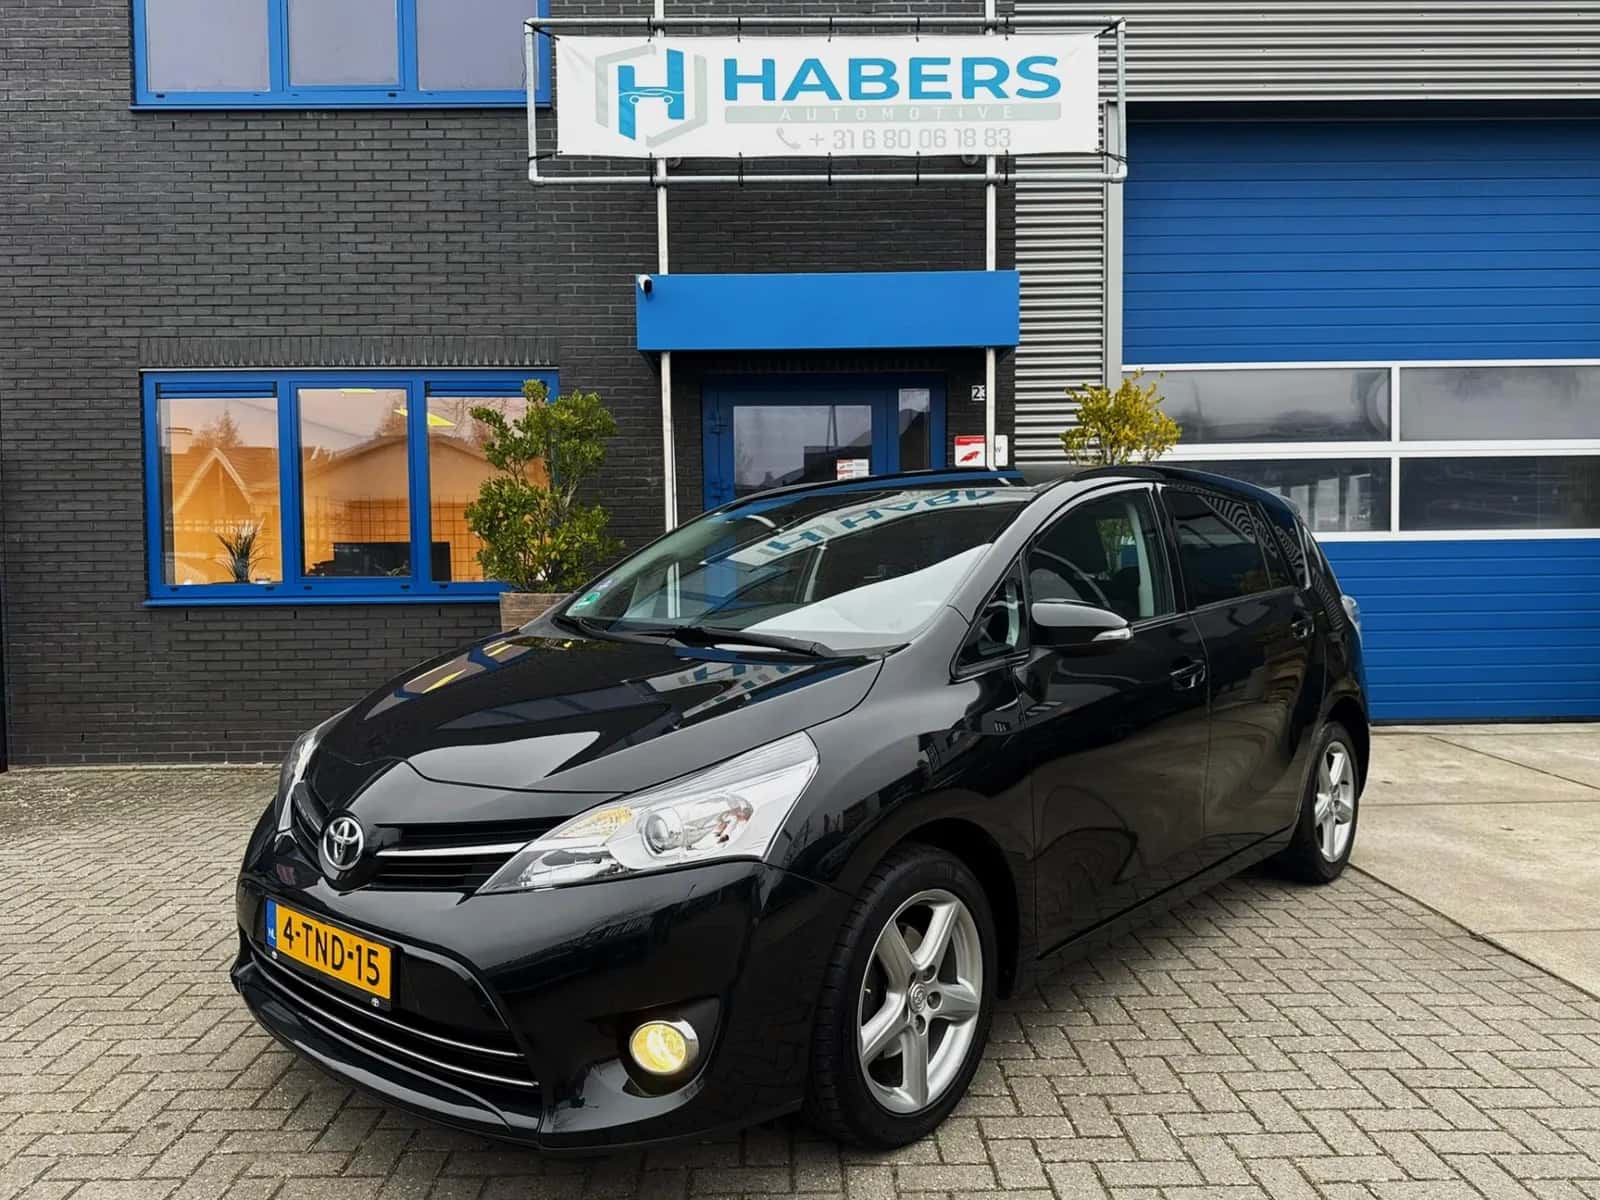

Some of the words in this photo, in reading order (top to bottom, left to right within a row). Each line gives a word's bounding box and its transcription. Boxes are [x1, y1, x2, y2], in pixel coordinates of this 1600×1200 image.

[723, 56, 1062, 101] HABERS
[779, 105, 1014, 121] AUTOMOTIVE
[883, 129, 912, 149] 80
[919, 129, 947, 149] 06
[955, 128, 977, 148] 18
[984, 128, 1012, 148] 83
[283, 915, 381, 986] 4-TND-15
